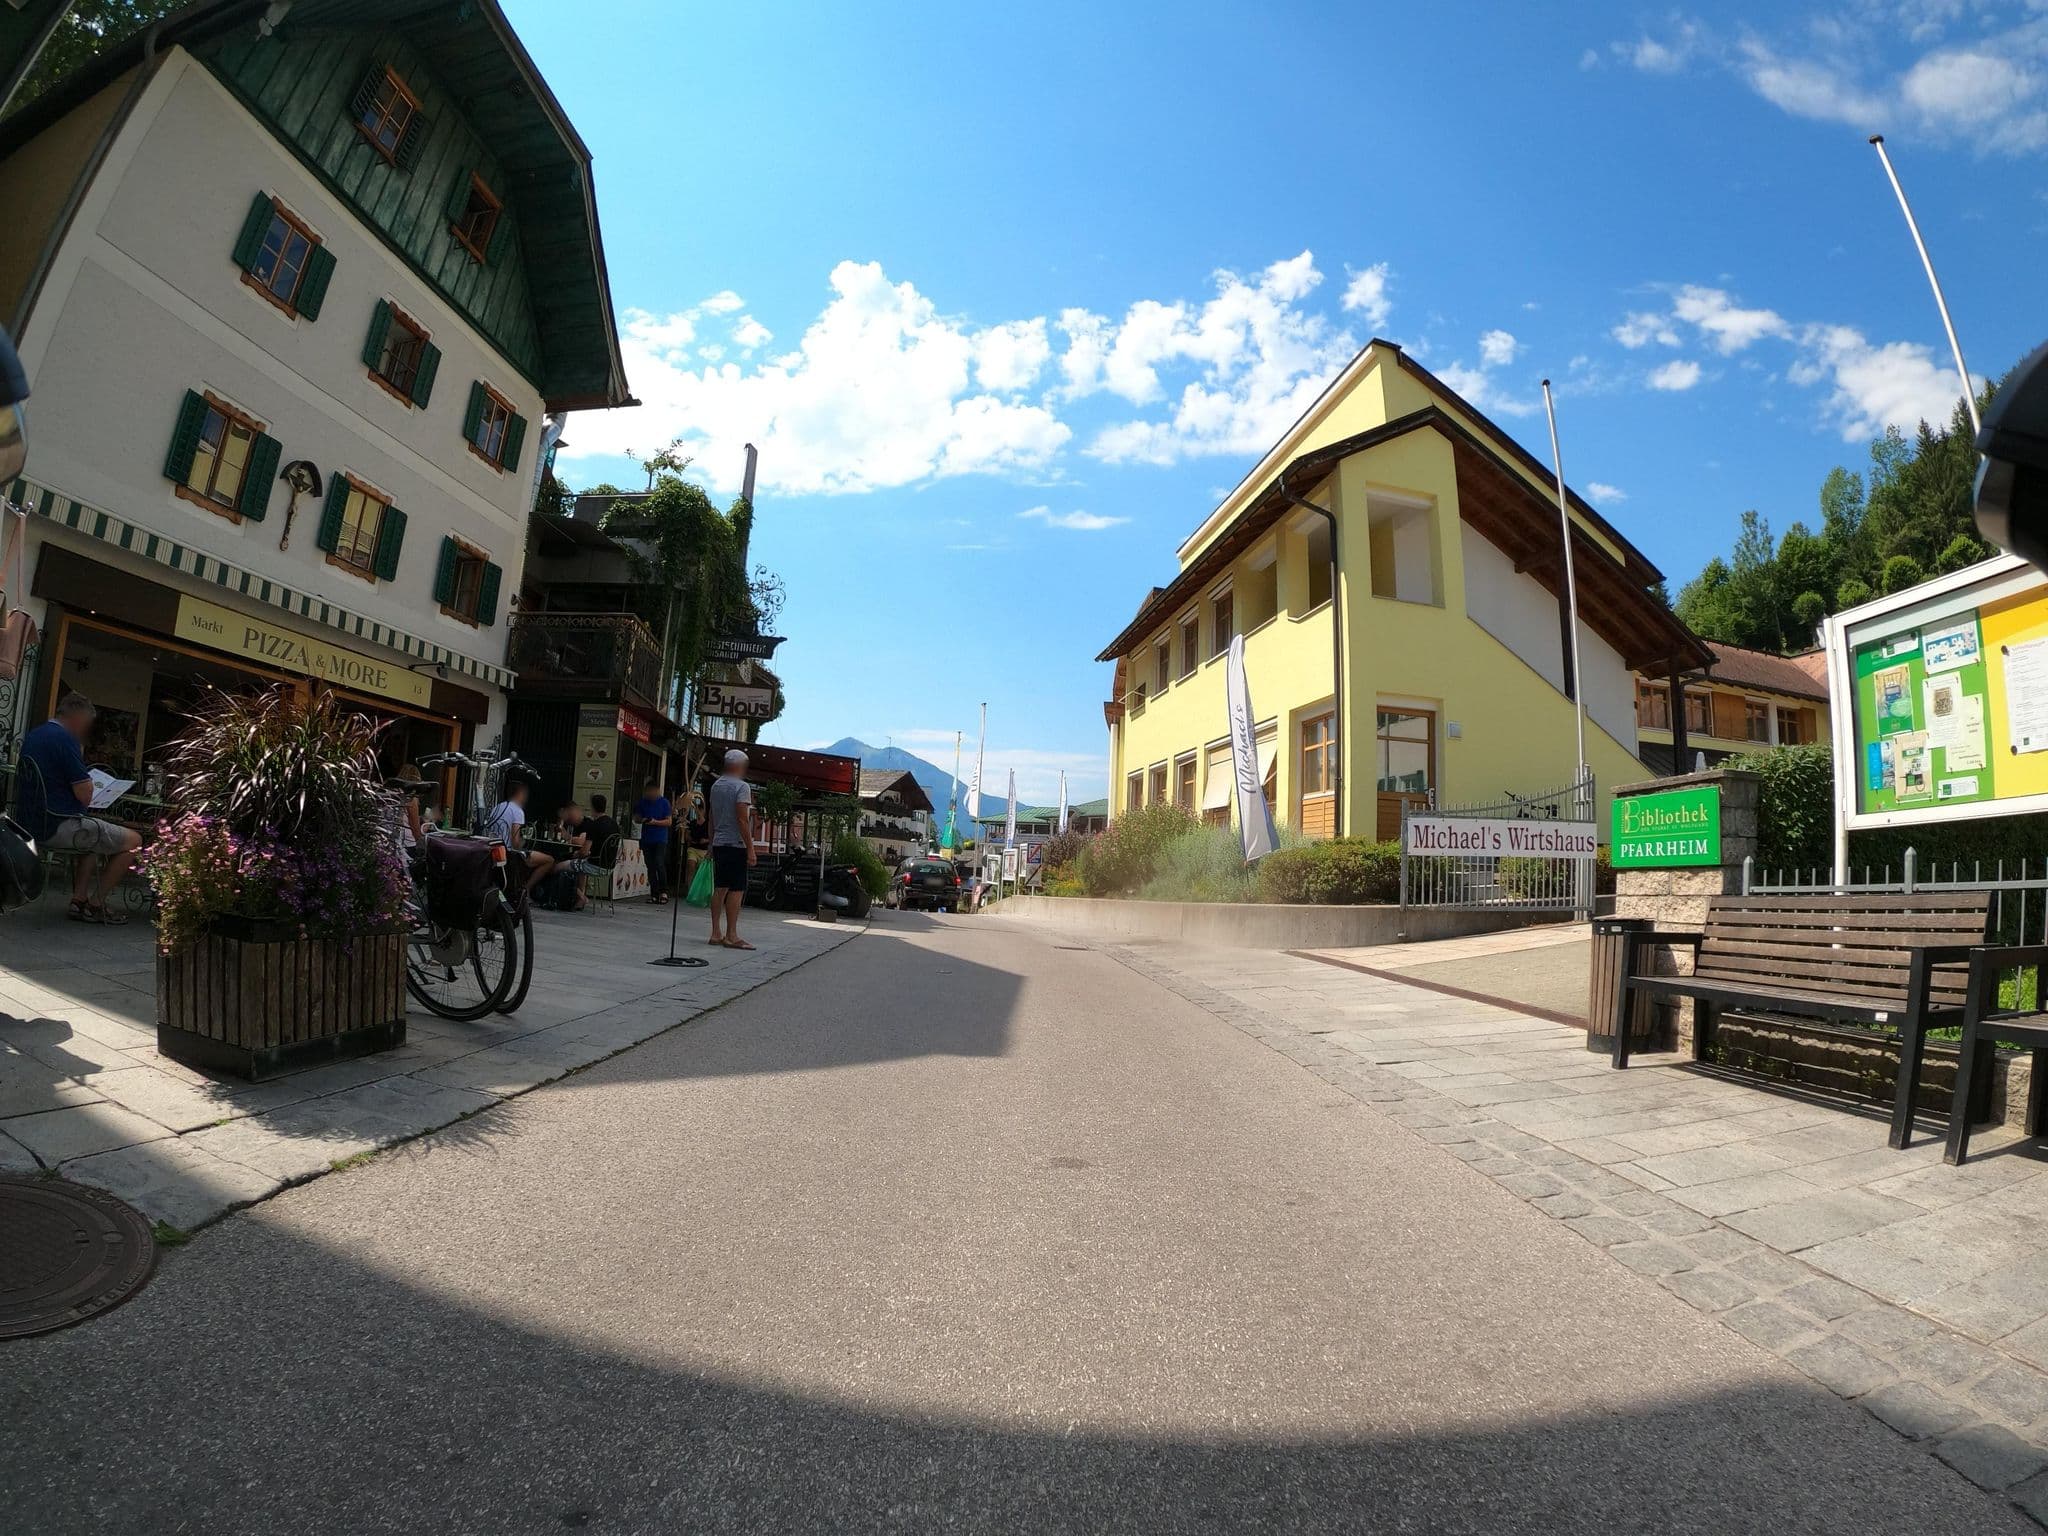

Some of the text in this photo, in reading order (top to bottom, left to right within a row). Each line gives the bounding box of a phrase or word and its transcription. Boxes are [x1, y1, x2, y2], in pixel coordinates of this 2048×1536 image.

[192, 615, 224, 635] Markt
[243, 627, 309, 667] PIZZA
[315, 655, 326, 668] &
[330, 655, 388, 690] MORE
[703, 686, 770, 717] 13 Haus
[1236, 703, 1257, 794] Michael's
[1621, 800, 1709, 834] Bibliothek
[1413, 824, 1596, 853] Michael's Wirtshaus
[1620, 839, 1709, 858] PFARRHEIM
